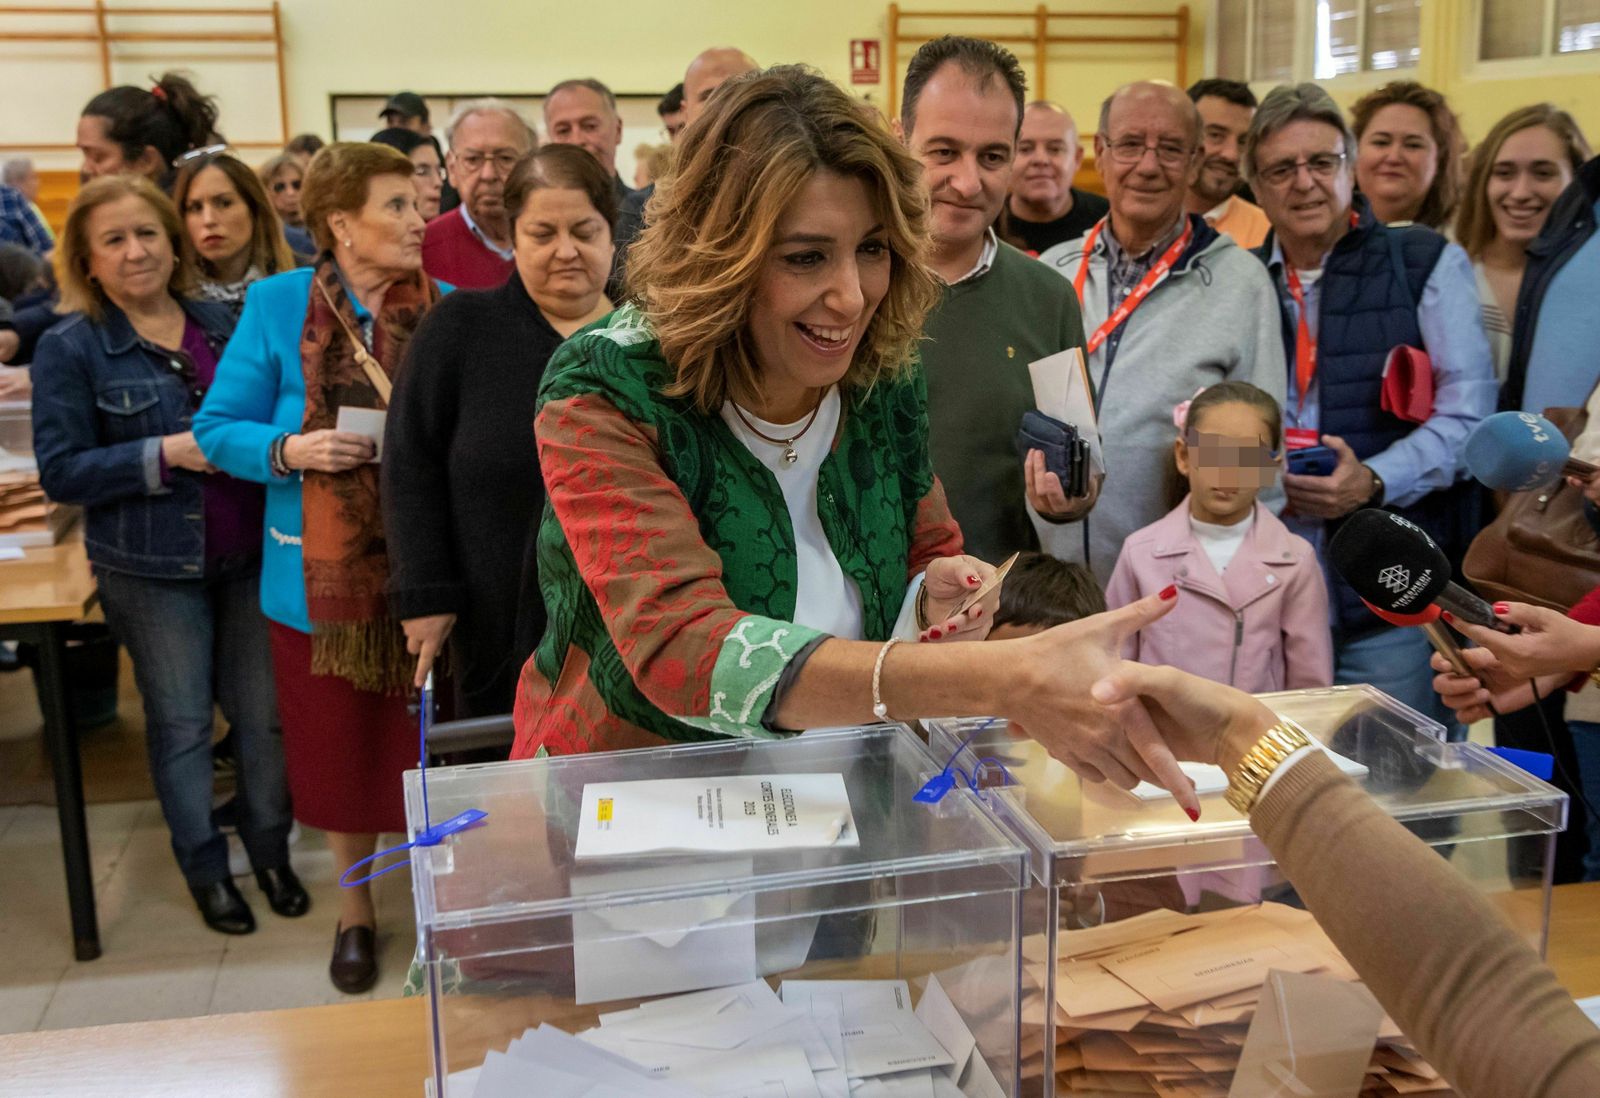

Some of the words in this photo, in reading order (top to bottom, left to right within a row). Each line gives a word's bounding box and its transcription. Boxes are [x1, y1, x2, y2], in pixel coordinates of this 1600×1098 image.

[1518, 412, 1549, 443] tve
[761, 781, 774, 802] CORTES
[781, 788, 797, 821] ELECCIONES
[763, 803, 779, 836] GENERALES
